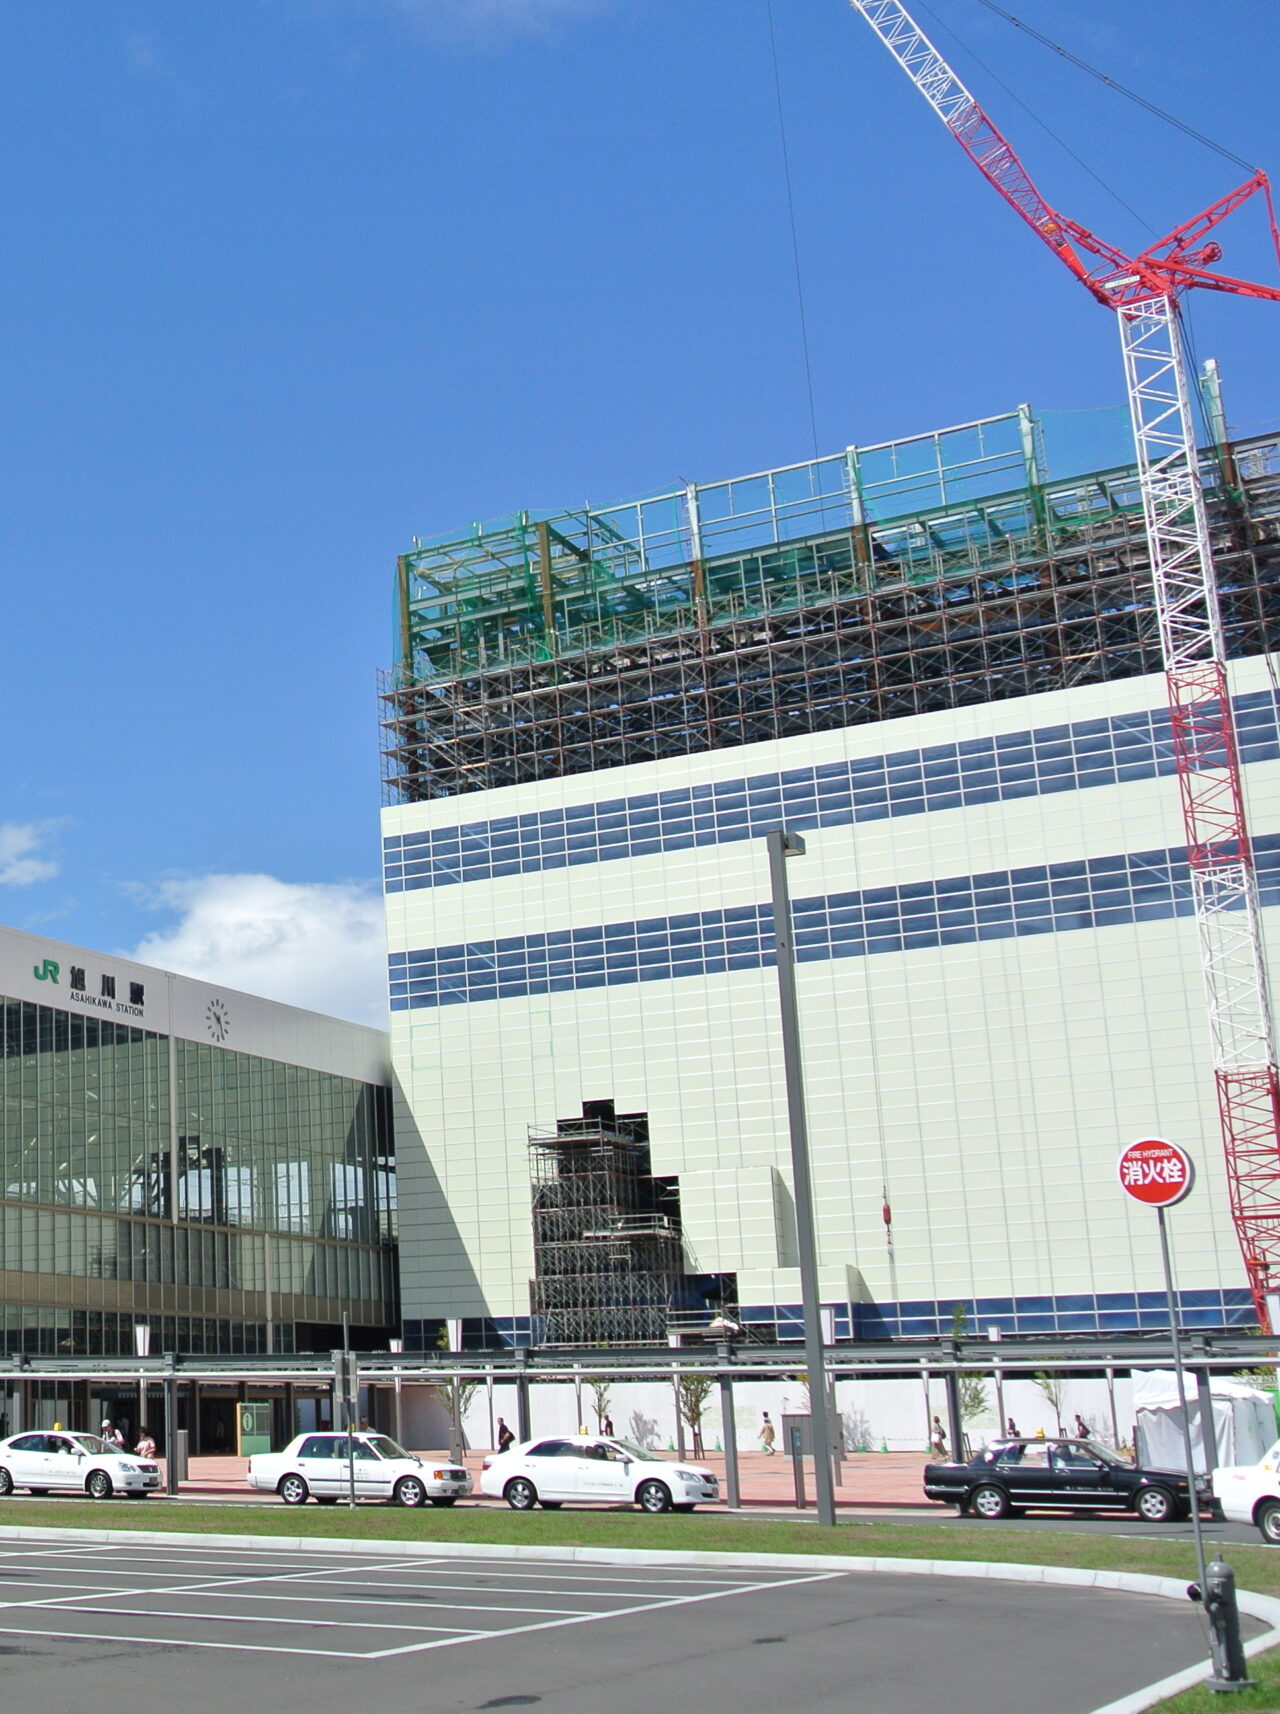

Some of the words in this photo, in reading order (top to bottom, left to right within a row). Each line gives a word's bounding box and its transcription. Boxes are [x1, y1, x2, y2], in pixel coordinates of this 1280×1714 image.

[33, 959, 60, 984] JR
[70, 991, 113, 1010] ASAHIKAWA
[115, 1002, 144, 1018] STATION
[1127, 1150, 1143, 1159] FIRE
[1143, 1148, 1173, 1158] HYDRANT
[1122, 1157, 1184, 1186] 消火栓
